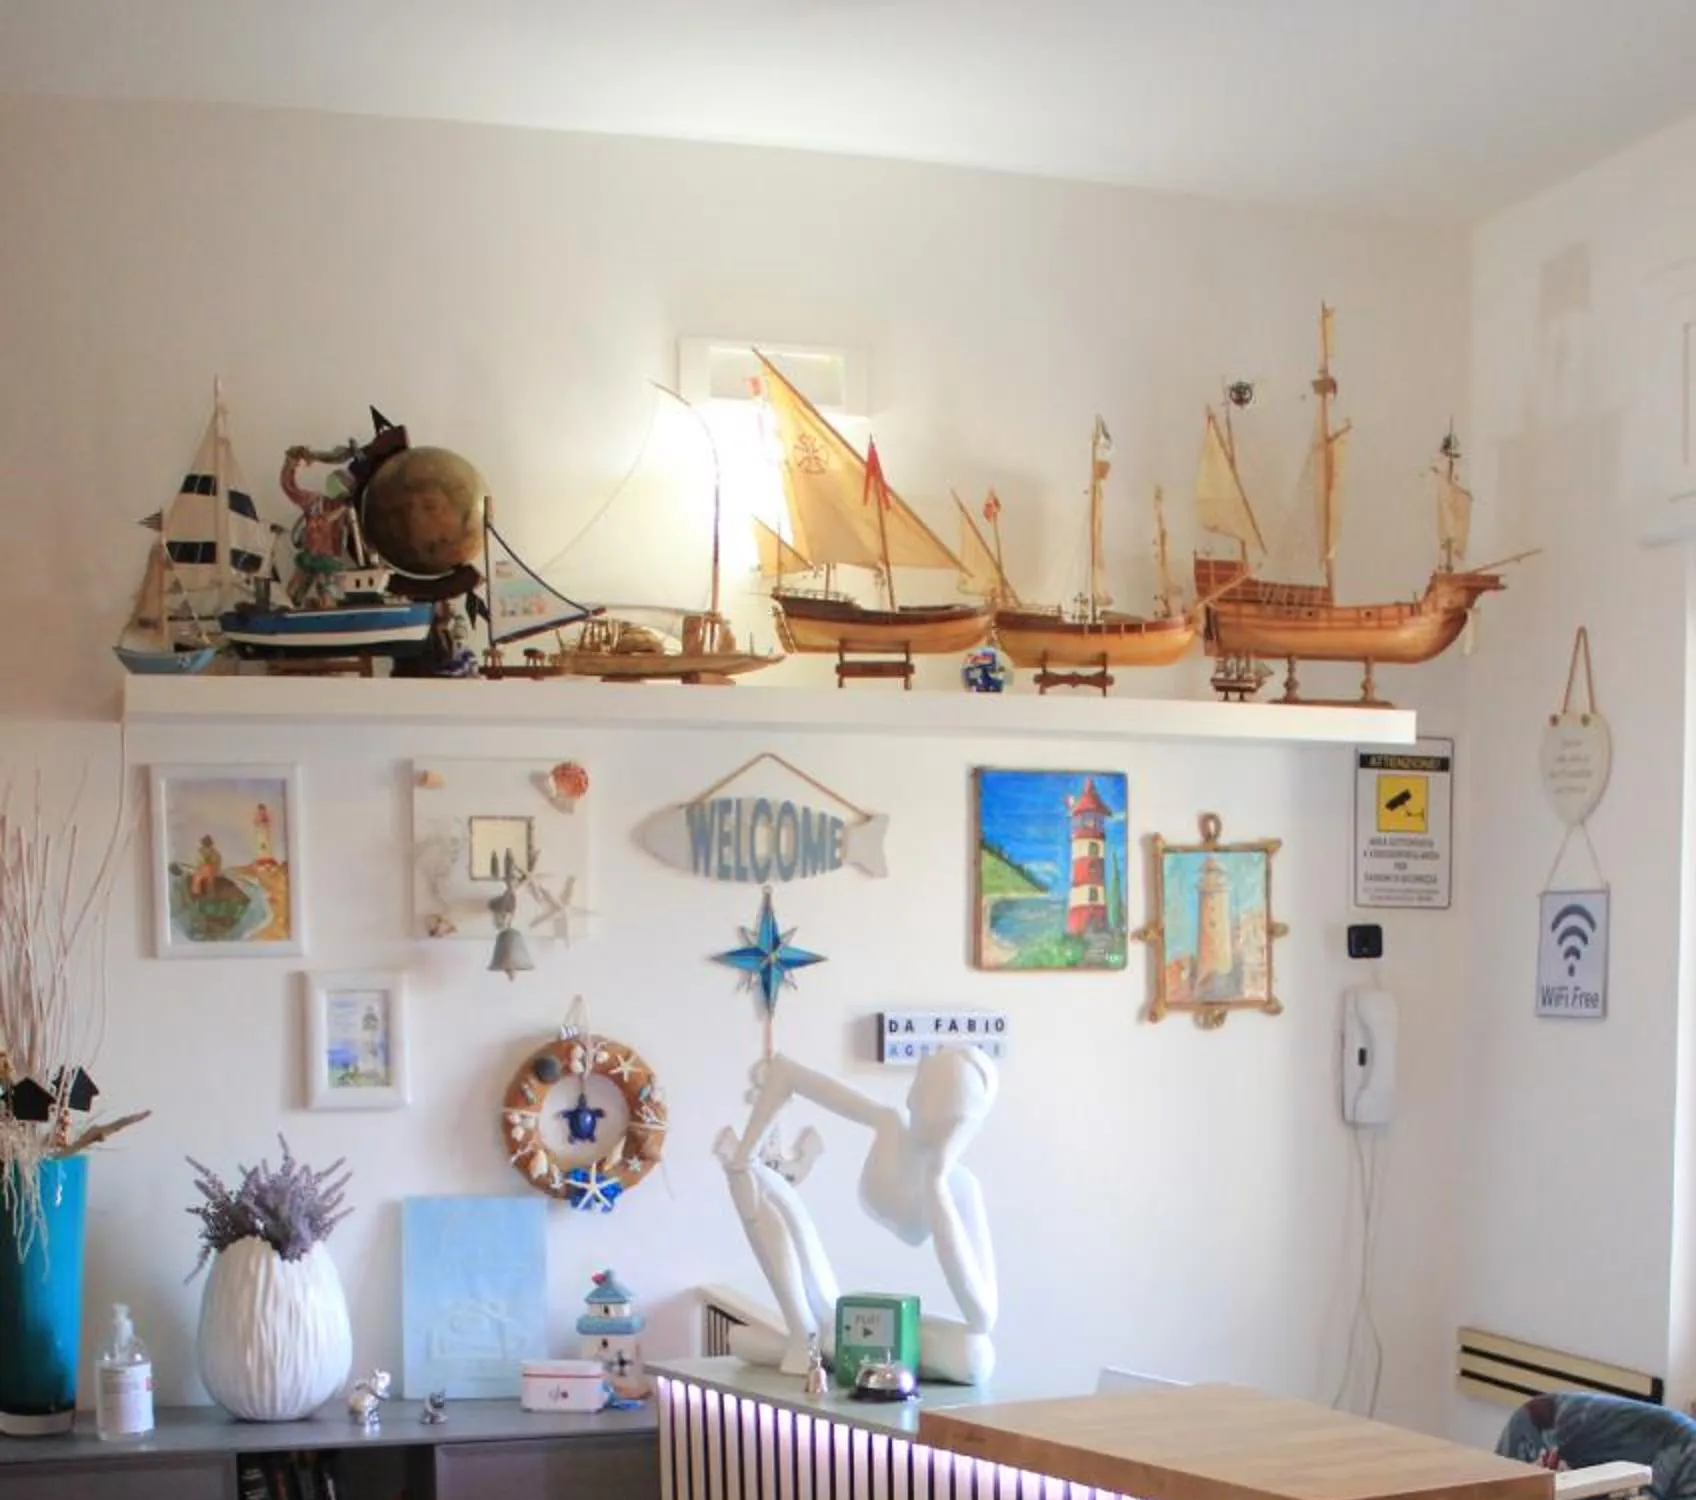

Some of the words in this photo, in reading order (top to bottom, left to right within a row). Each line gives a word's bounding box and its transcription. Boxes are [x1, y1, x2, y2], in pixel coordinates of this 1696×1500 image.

[685, 797, 845, 883] WELCOME
[1571, 985, 1600, 1009] Free
[888, 1019, 915, 1034] DA
[934, 1018, 1005, 1034] FABIO
